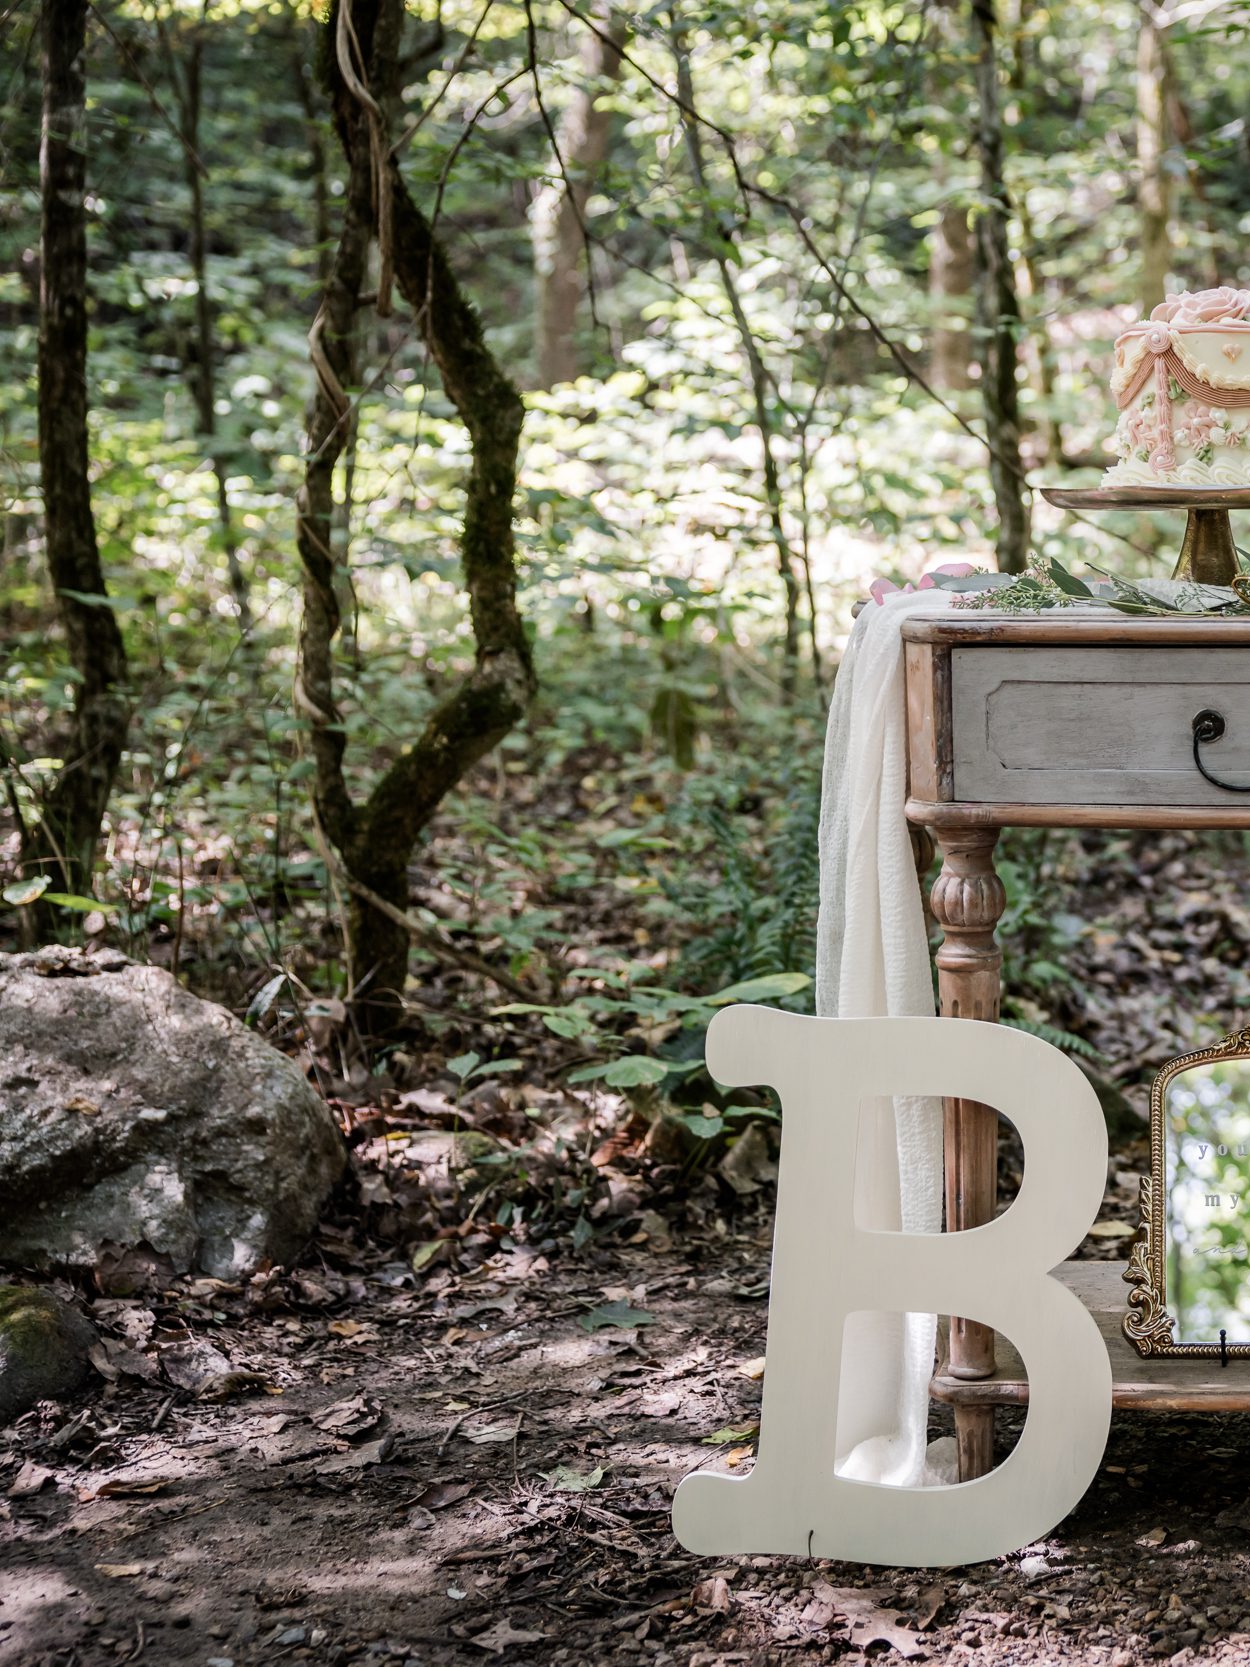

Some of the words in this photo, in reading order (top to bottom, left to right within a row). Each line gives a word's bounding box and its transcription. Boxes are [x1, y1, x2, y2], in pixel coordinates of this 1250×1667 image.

[1198, 1144, 1248, 1160] you
[1204, 1192, 1241, 1209] my
[1192, 1240, 1247, 1256] and
[672, 1003, 1112, 1567] B
